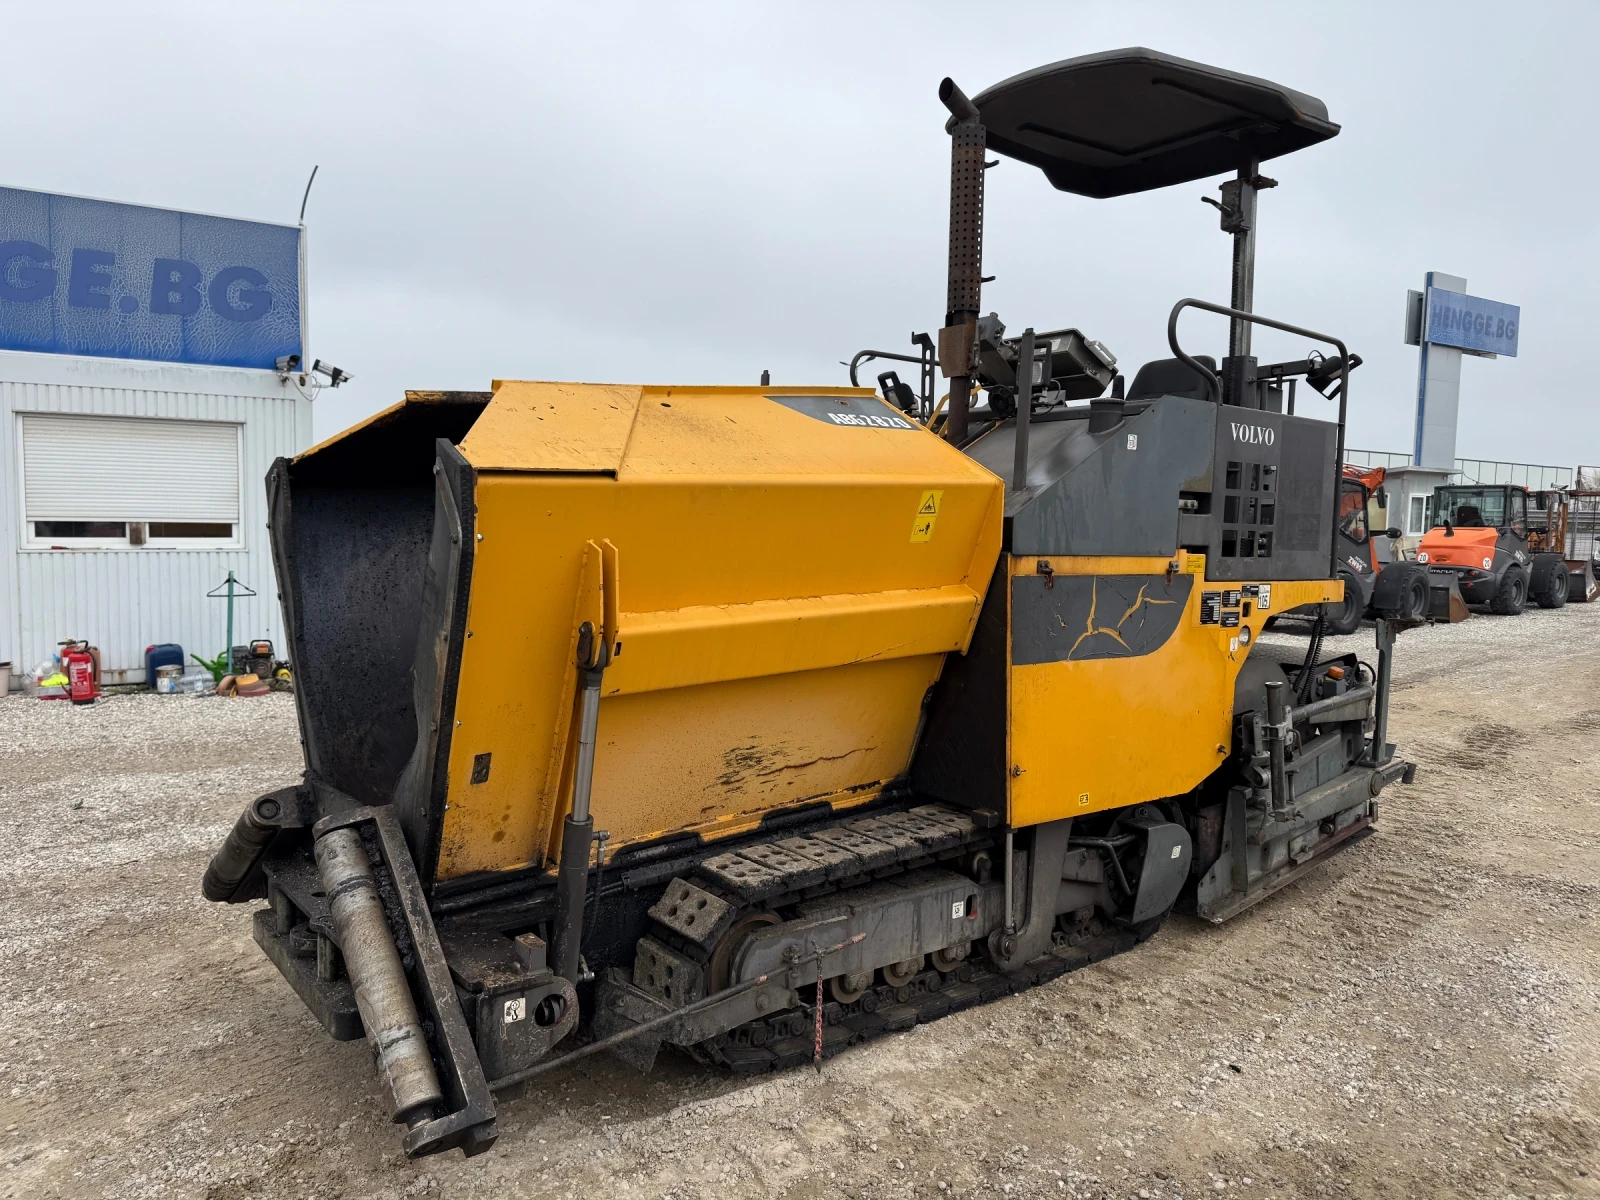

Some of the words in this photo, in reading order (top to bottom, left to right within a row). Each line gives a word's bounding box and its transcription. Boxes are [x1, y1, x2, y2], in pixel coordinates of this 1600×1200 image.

[0, 240, 272, 323] GE.BG
[1432, 304, 1516, 341] HENGGE.BG
[827, 412, 912, 429] ABG2820
[1230, 422, 1275, 446] VOLVO
[1419, 554, 1427, 562] 20
[1259, 594, 1268, 608] 105
